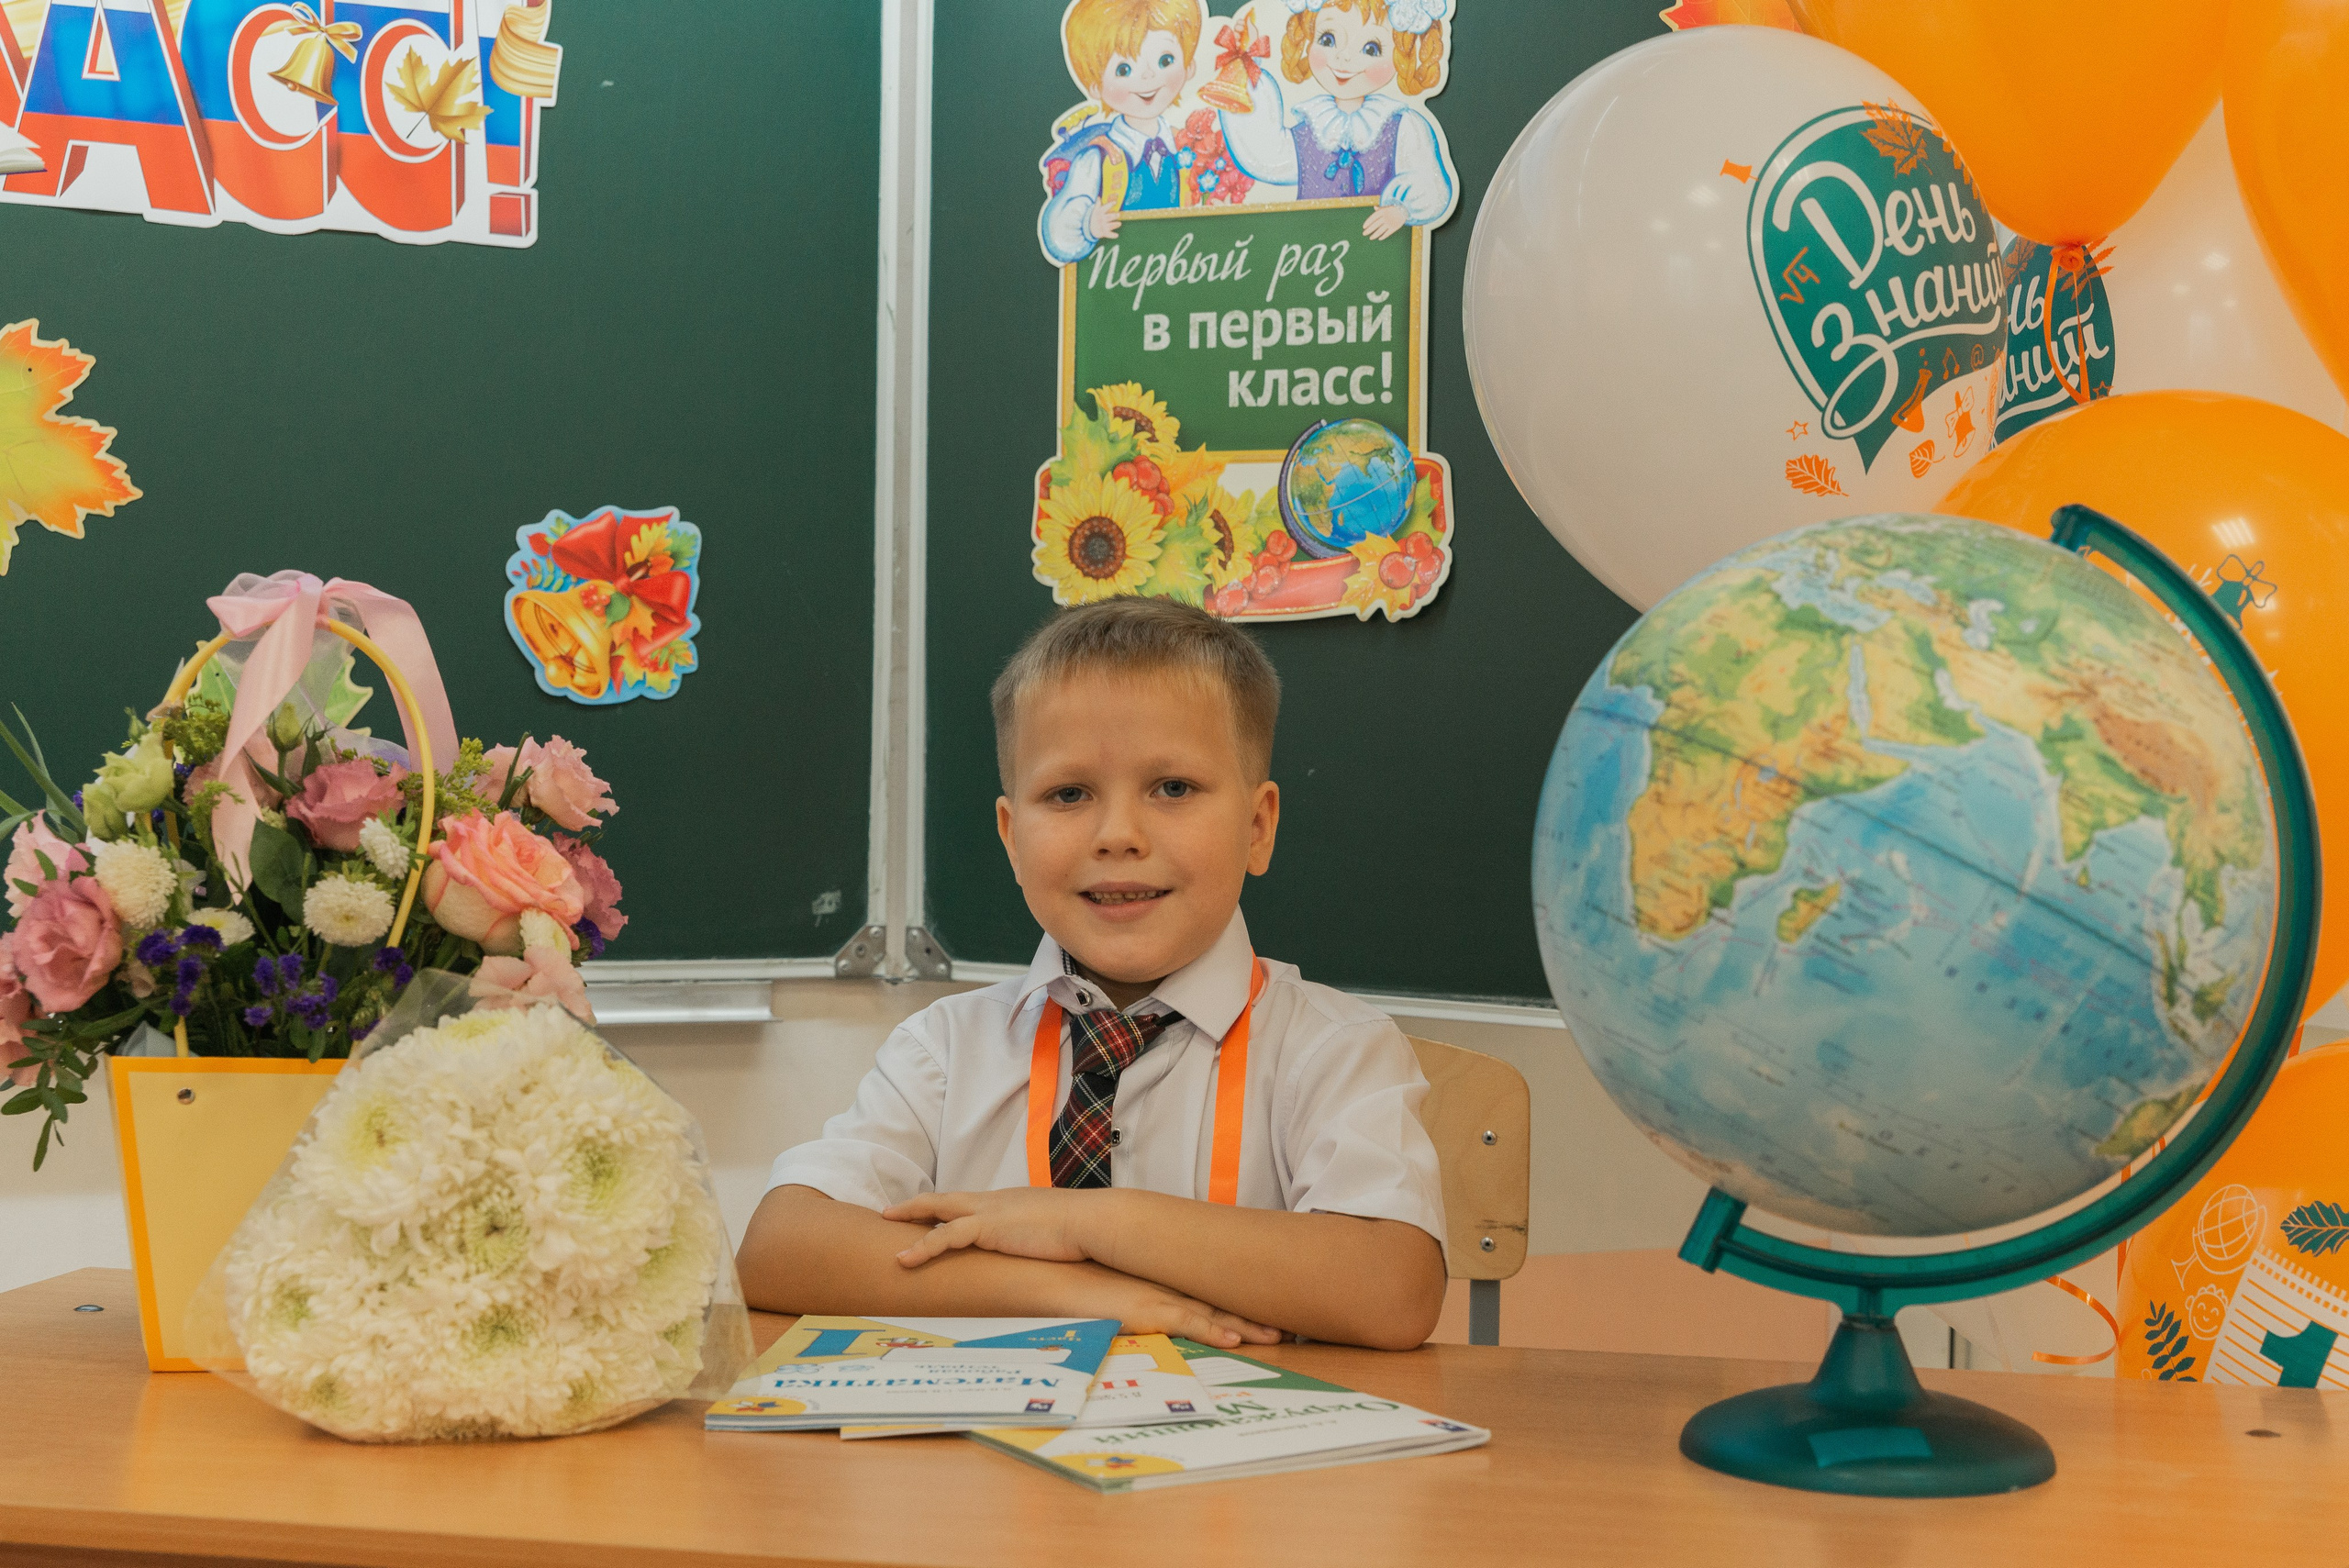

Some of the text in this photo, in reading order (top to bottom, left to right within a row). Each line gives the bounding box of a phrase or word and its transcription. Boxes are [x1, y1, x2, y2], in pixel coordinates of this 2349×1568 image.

[0, 0, 532, 238] АСС!
[1773, 161, 1976, 290] День
[1087, 232, 1351, 311] Первый раз
[1142, 290, 1393, 361] в первый
[1811, 241, 2004, 439] Знаний
[1228, 350, 1393, 408] класс!
[774, 1375, 1063, 1391] Математика
